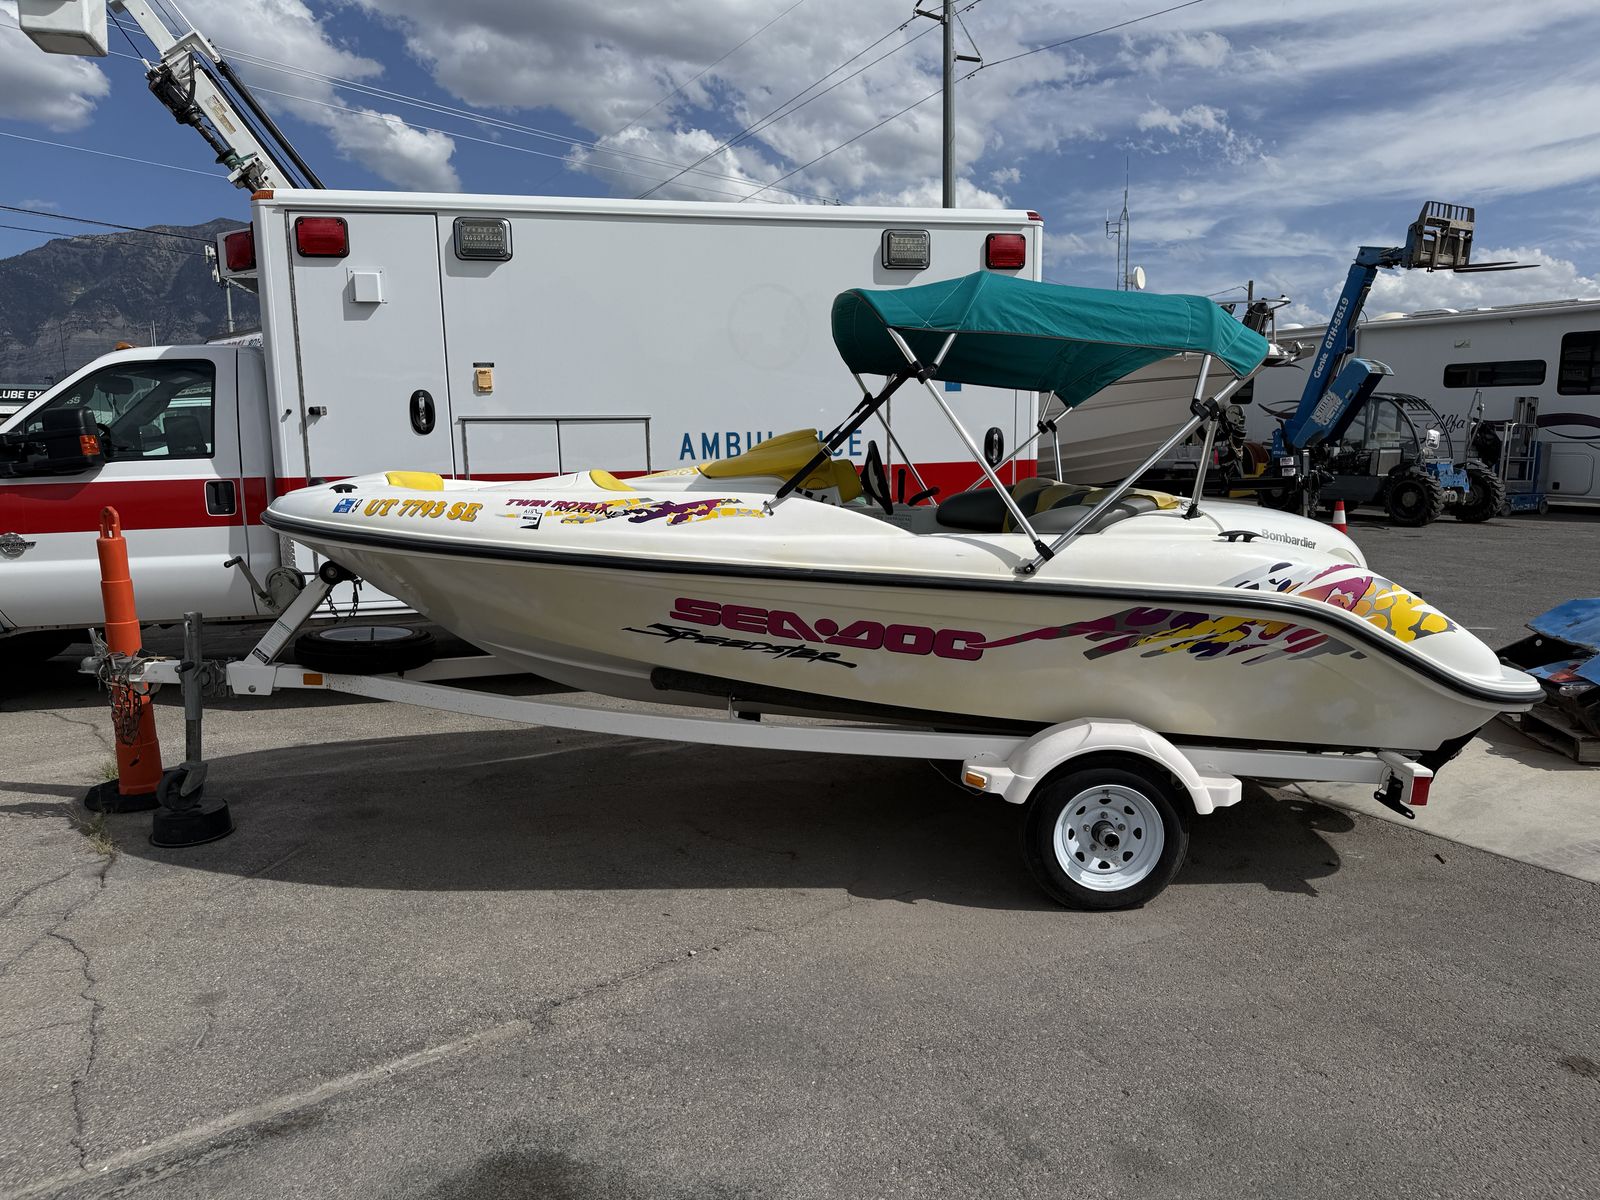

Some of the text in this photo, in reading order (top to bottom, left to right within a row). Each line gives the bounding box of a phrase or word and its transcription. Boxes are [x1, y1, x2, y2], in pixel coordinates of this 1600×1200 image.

[1325, 297, 1349, 349] GTH-5519
[364, 498, 400, 517] UT
[398, 499, 446, 519] 7793
[446, 501, 483, 522] SE
[505, 499, 614, 512] TWIN ROTAX
[1261, 529, 1316, 549] Bombardier
